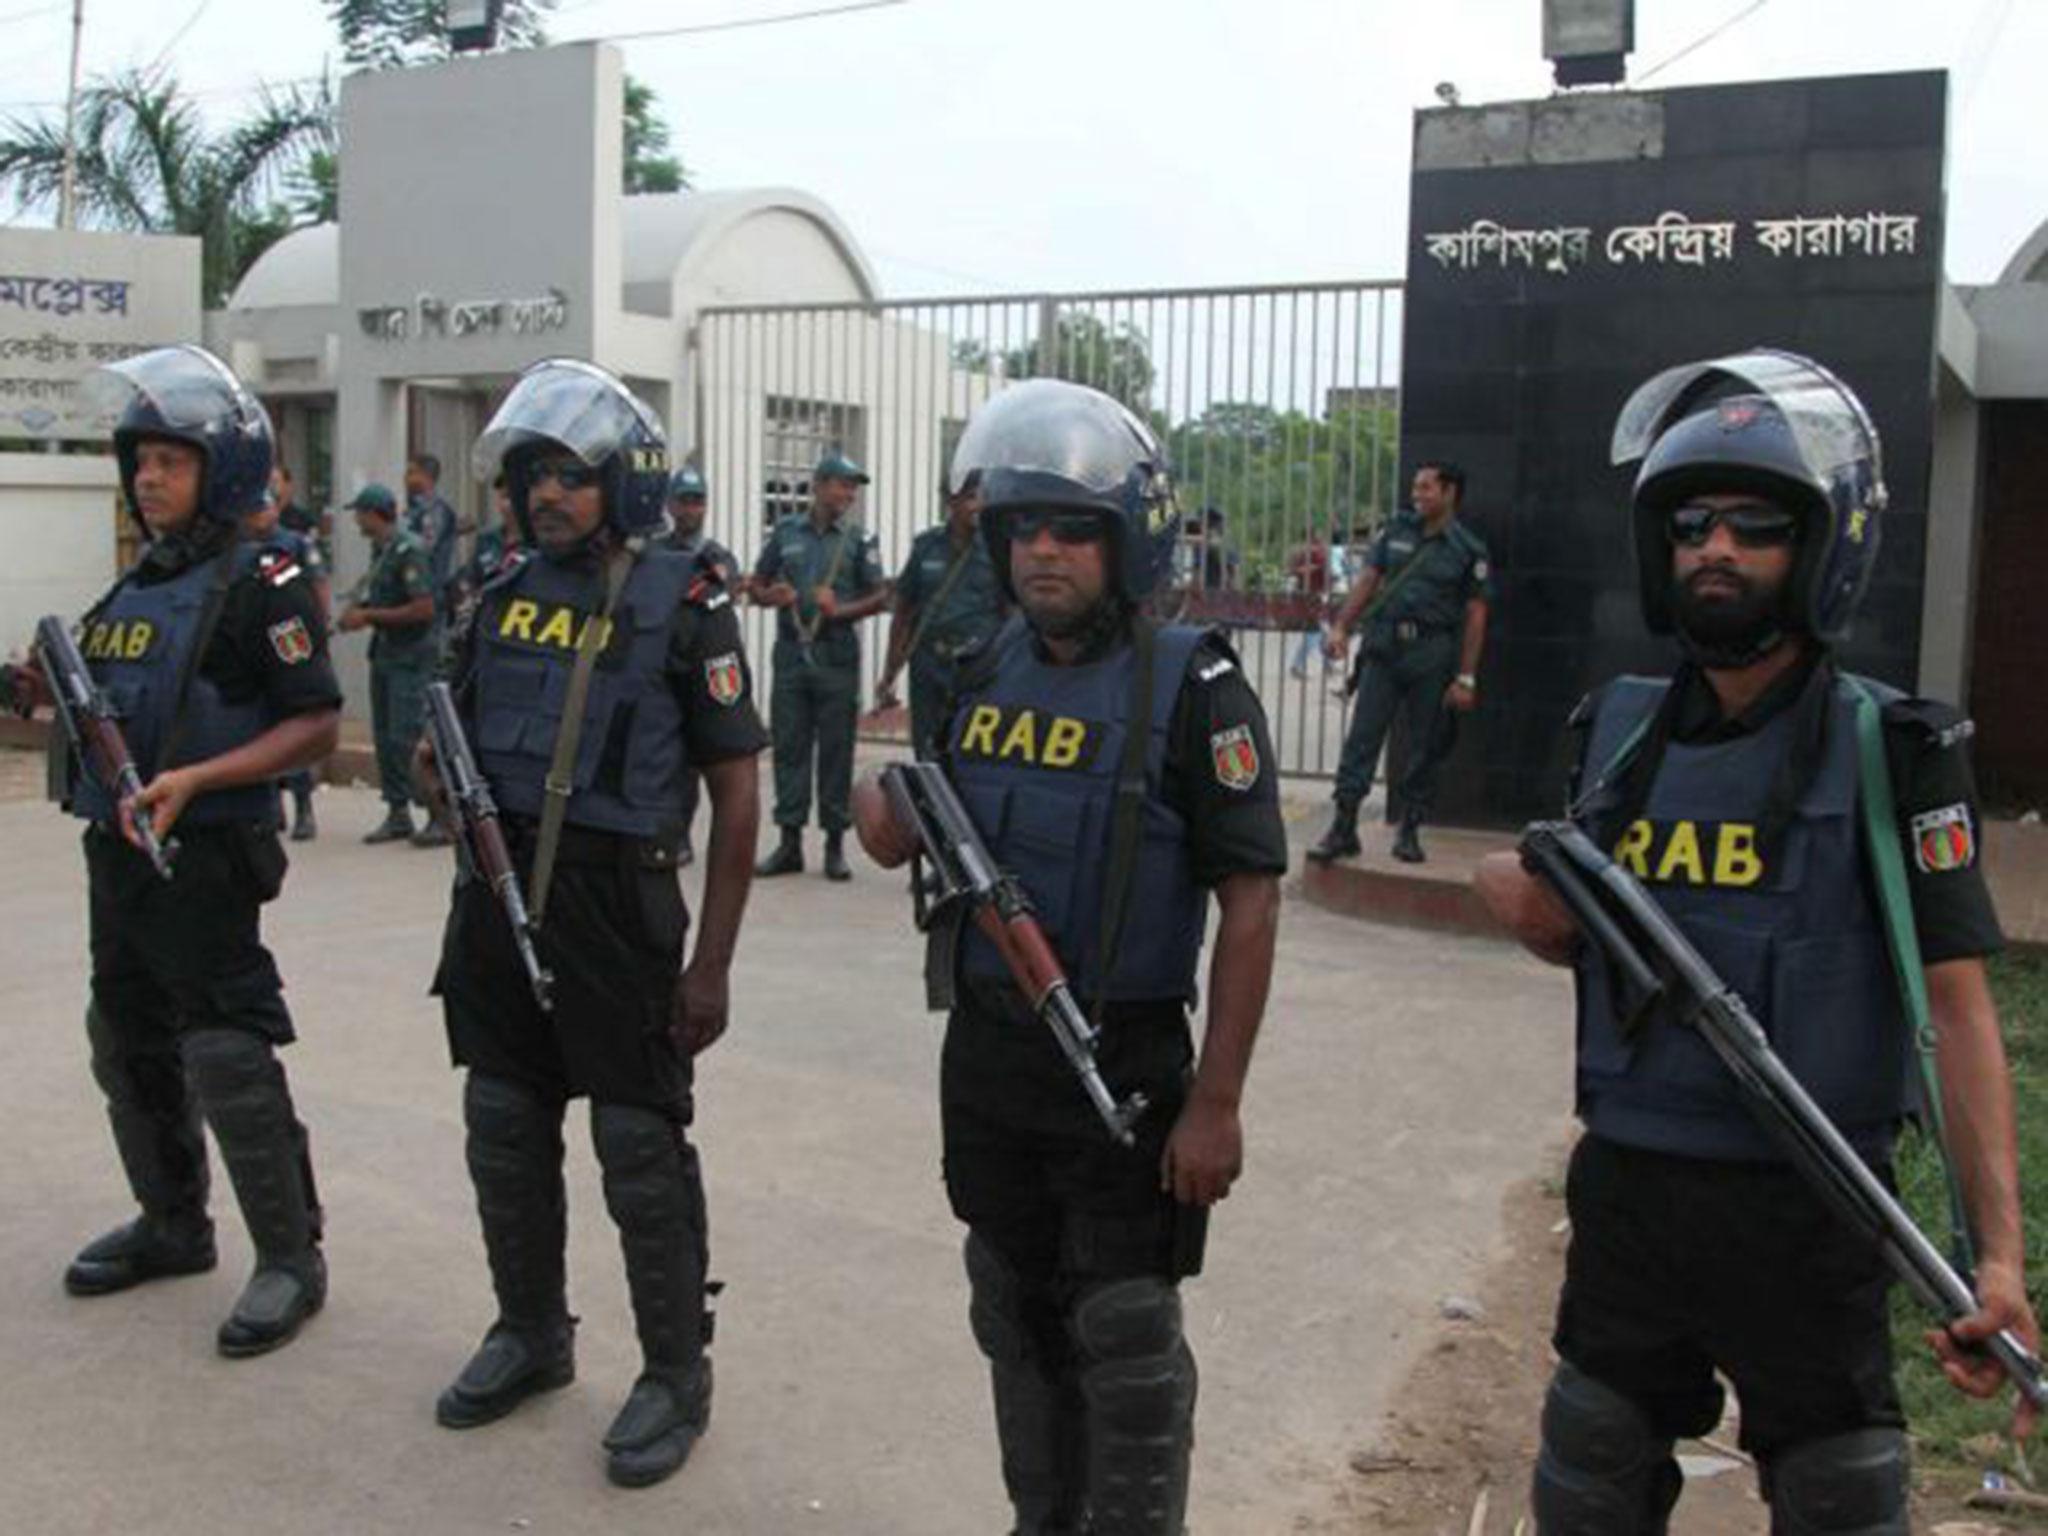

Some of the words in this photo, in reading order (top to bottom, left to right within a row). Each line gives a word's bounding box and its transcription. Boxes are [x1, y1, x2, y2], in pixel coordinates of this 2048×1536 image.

[1425, 219, 1592, 274] কাশিমপুর
[1754, 211, 1919, 257] কারাগার
[84, 620, 153, 661] RAB
[961, 704, 1087, 768] RAB
[1614, 818, 1763, 887] RAB
